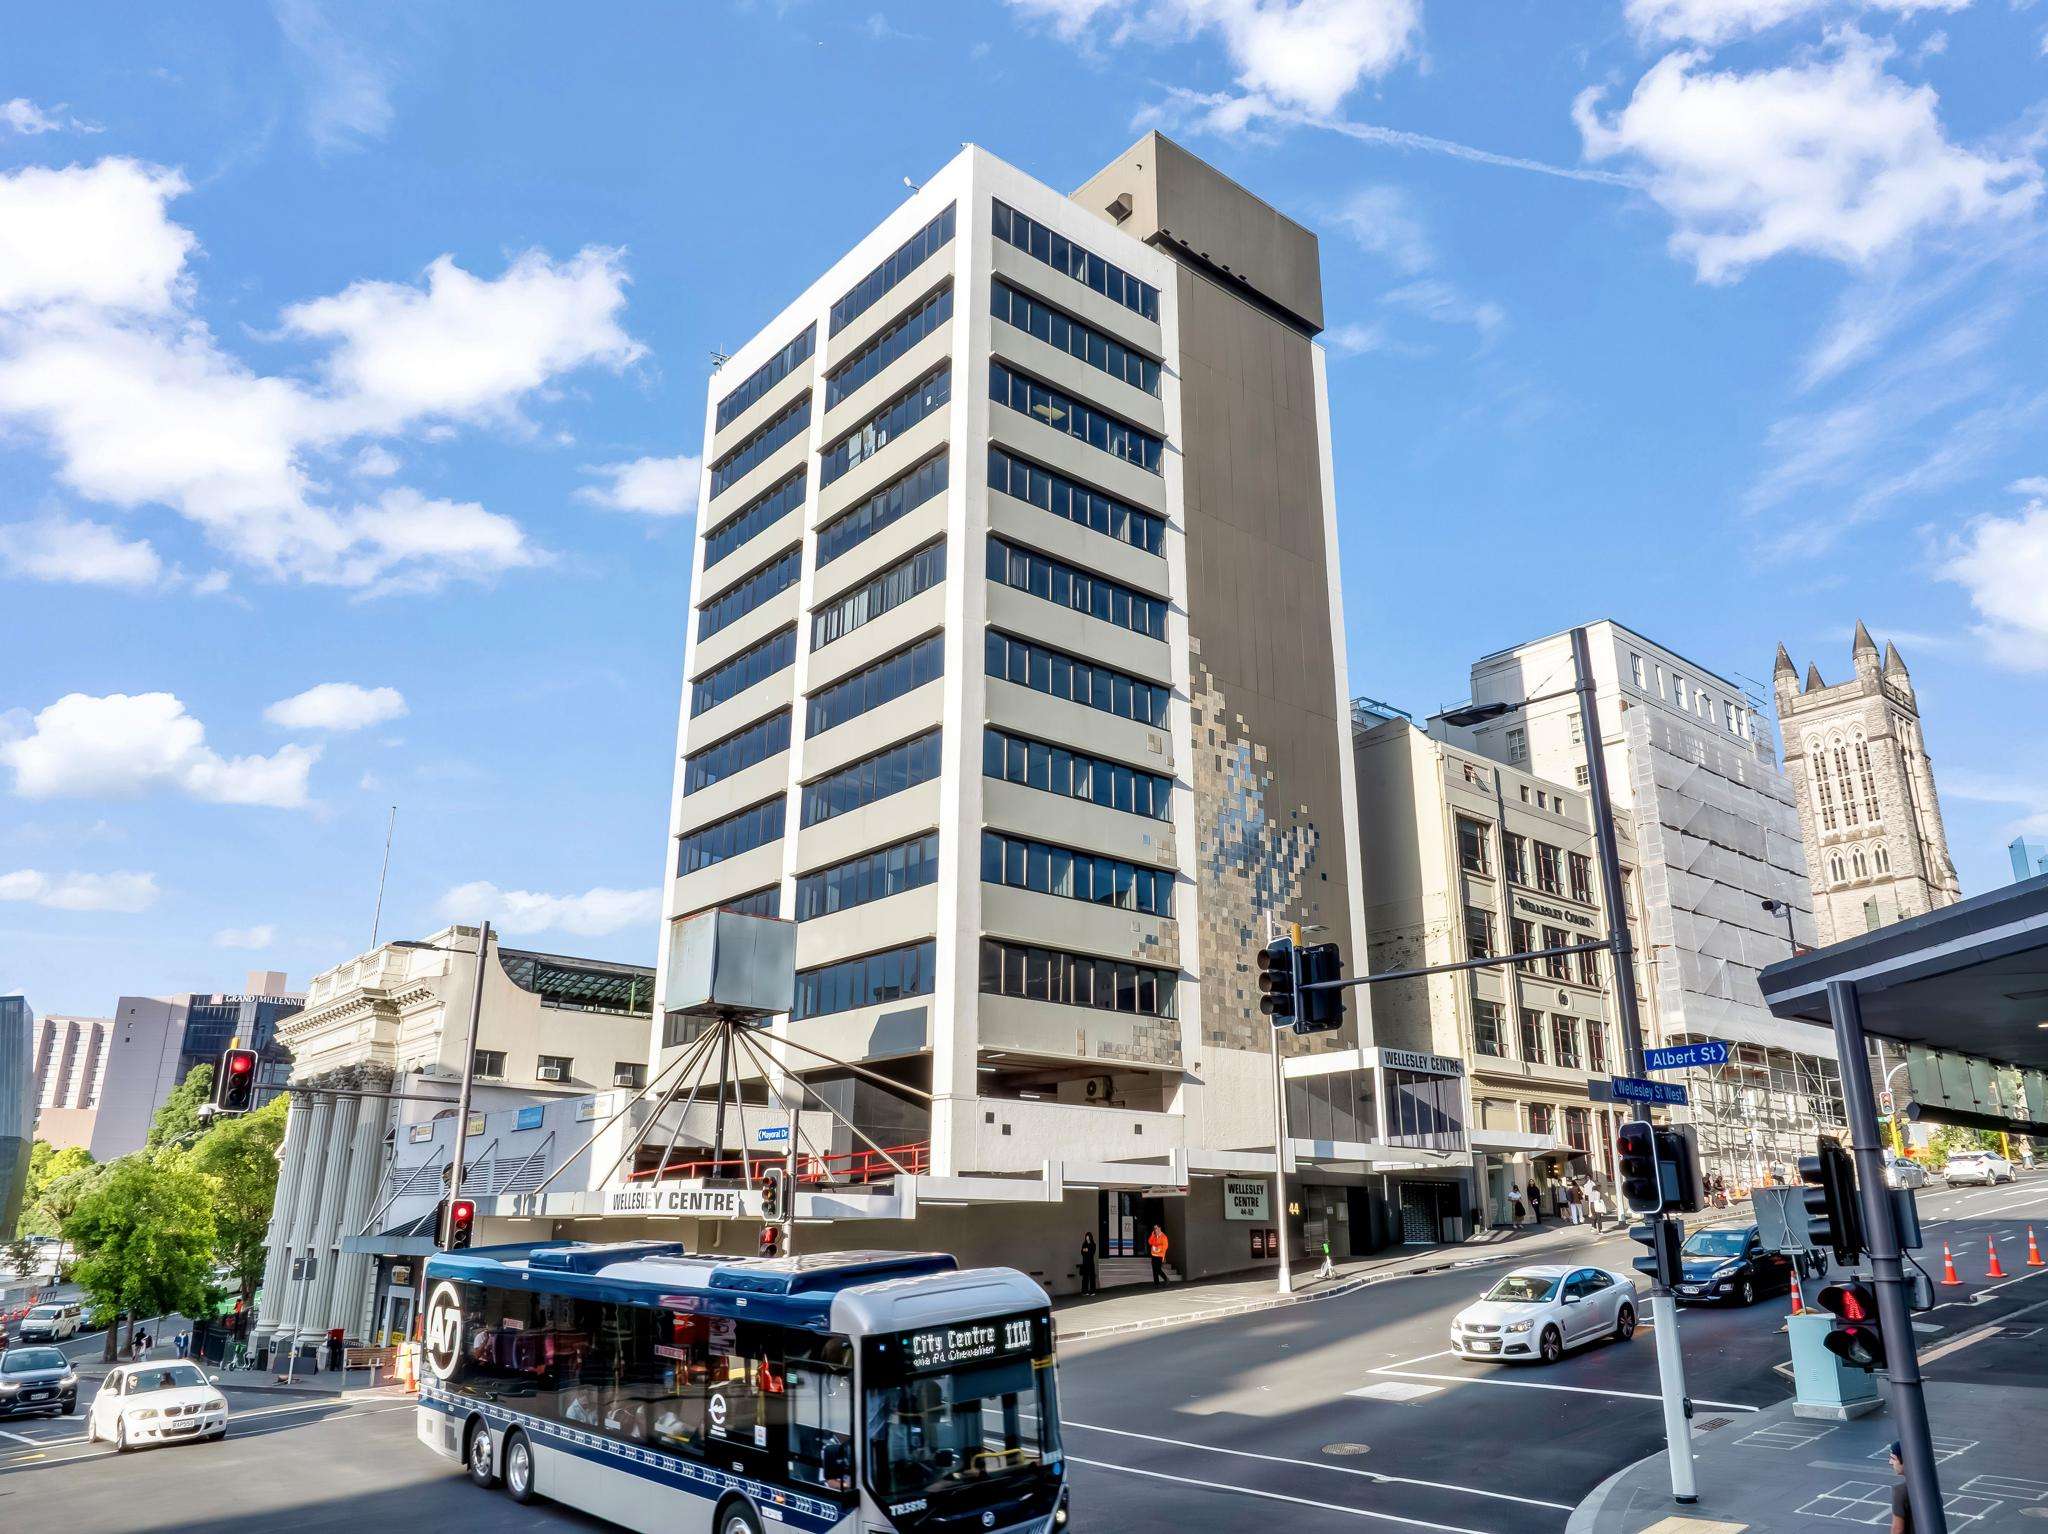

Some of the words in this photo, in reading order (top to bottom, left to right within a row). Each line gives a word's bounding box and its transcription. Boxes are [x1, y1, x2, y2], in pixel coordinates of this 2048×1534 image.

[225, 994, 256, 1003] GRAND
[1384, 1050, 1428, 1070] WELLESLEY
[1431, 1057, 1460, 1073] CENTRE
[1653, 1049, 1696, 1067] Albert
[1701, 1047, 1717, 1062] St
[1617, 1081, 1653, 1101] Wellesley
[1654, 1085, 1664, 1099] St
[1665, 1086, 1683, 1101] West
[1228, 1183, 1265, 1195] WELLESLEY
[613, 1192, 661, 1211] WELLESLEY
[669, 1192, 735, 1211] CENTRE
[1234, 1196, 1260, 1208] CENTRE
[1289, 1202, 1300, 1215] 44
[912, 1333, 943, 1355] City
[948, 1326, 995, 1349] Centre
